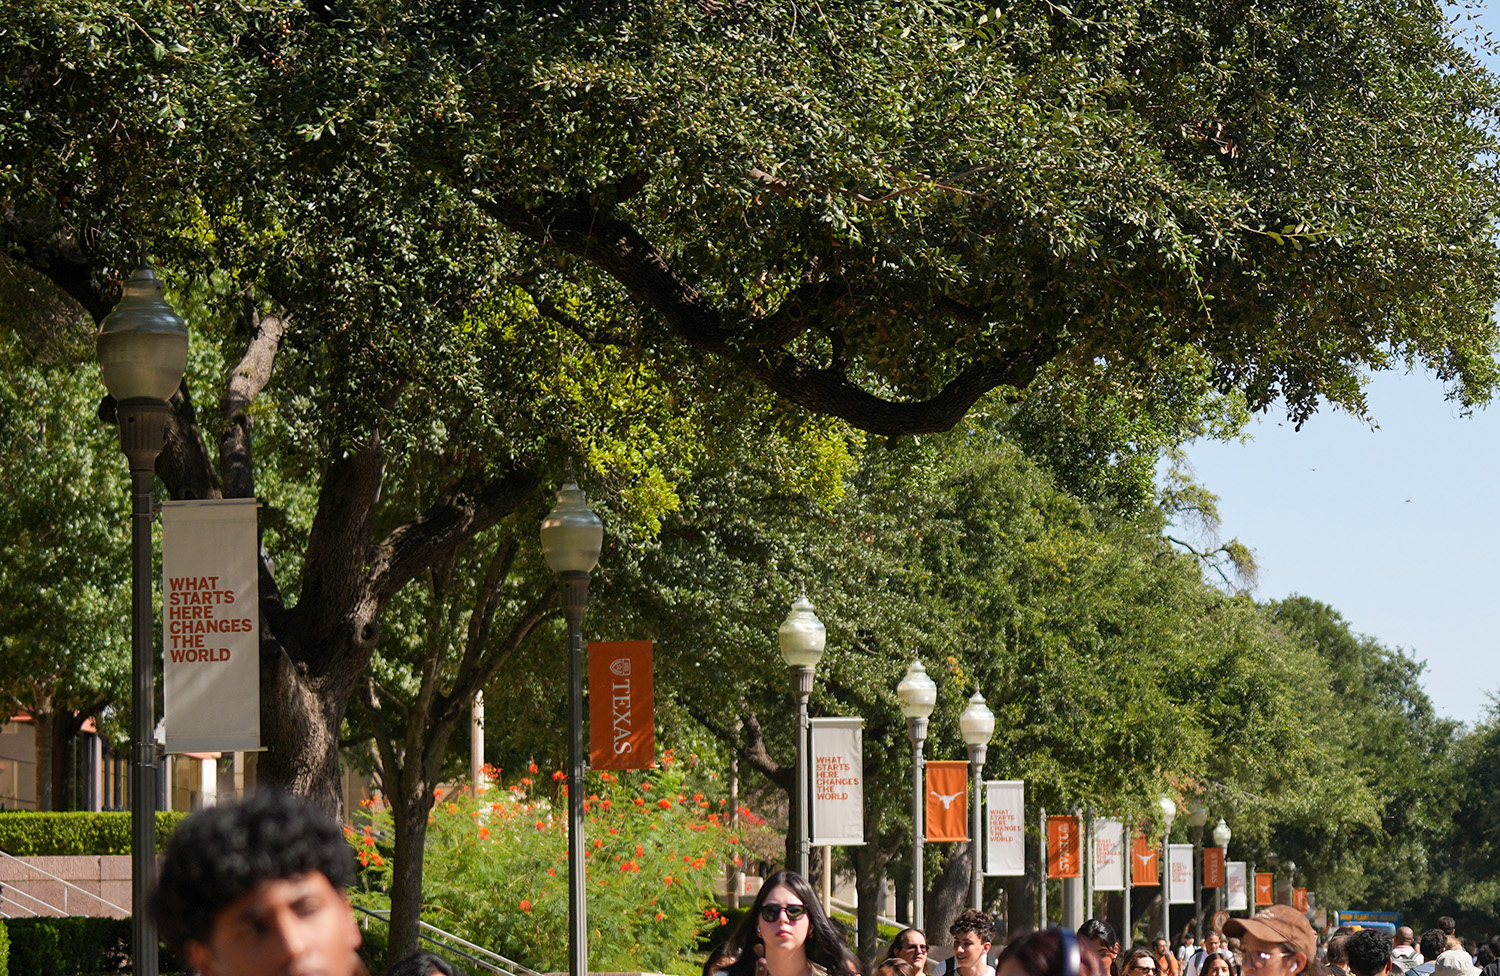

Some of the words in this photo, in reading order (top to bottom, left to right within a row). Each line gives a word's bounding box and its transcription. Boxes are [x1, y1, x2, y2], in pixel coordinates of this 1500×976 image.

[169, 577, 219, 590] WHAT
[169, 590, 235, 605] STARTS
[169, 606, 213, 619] HERE
[169, 619, 252, 634] CHANGES
[170, 635, 205, 648] THE
[170, 648, 231, 663] WORLD
[612, 679, 632, 754] TEXAS
[816, 763, 850, 771] STARTS
[1060, 833, 1070, 871] TEXAS
